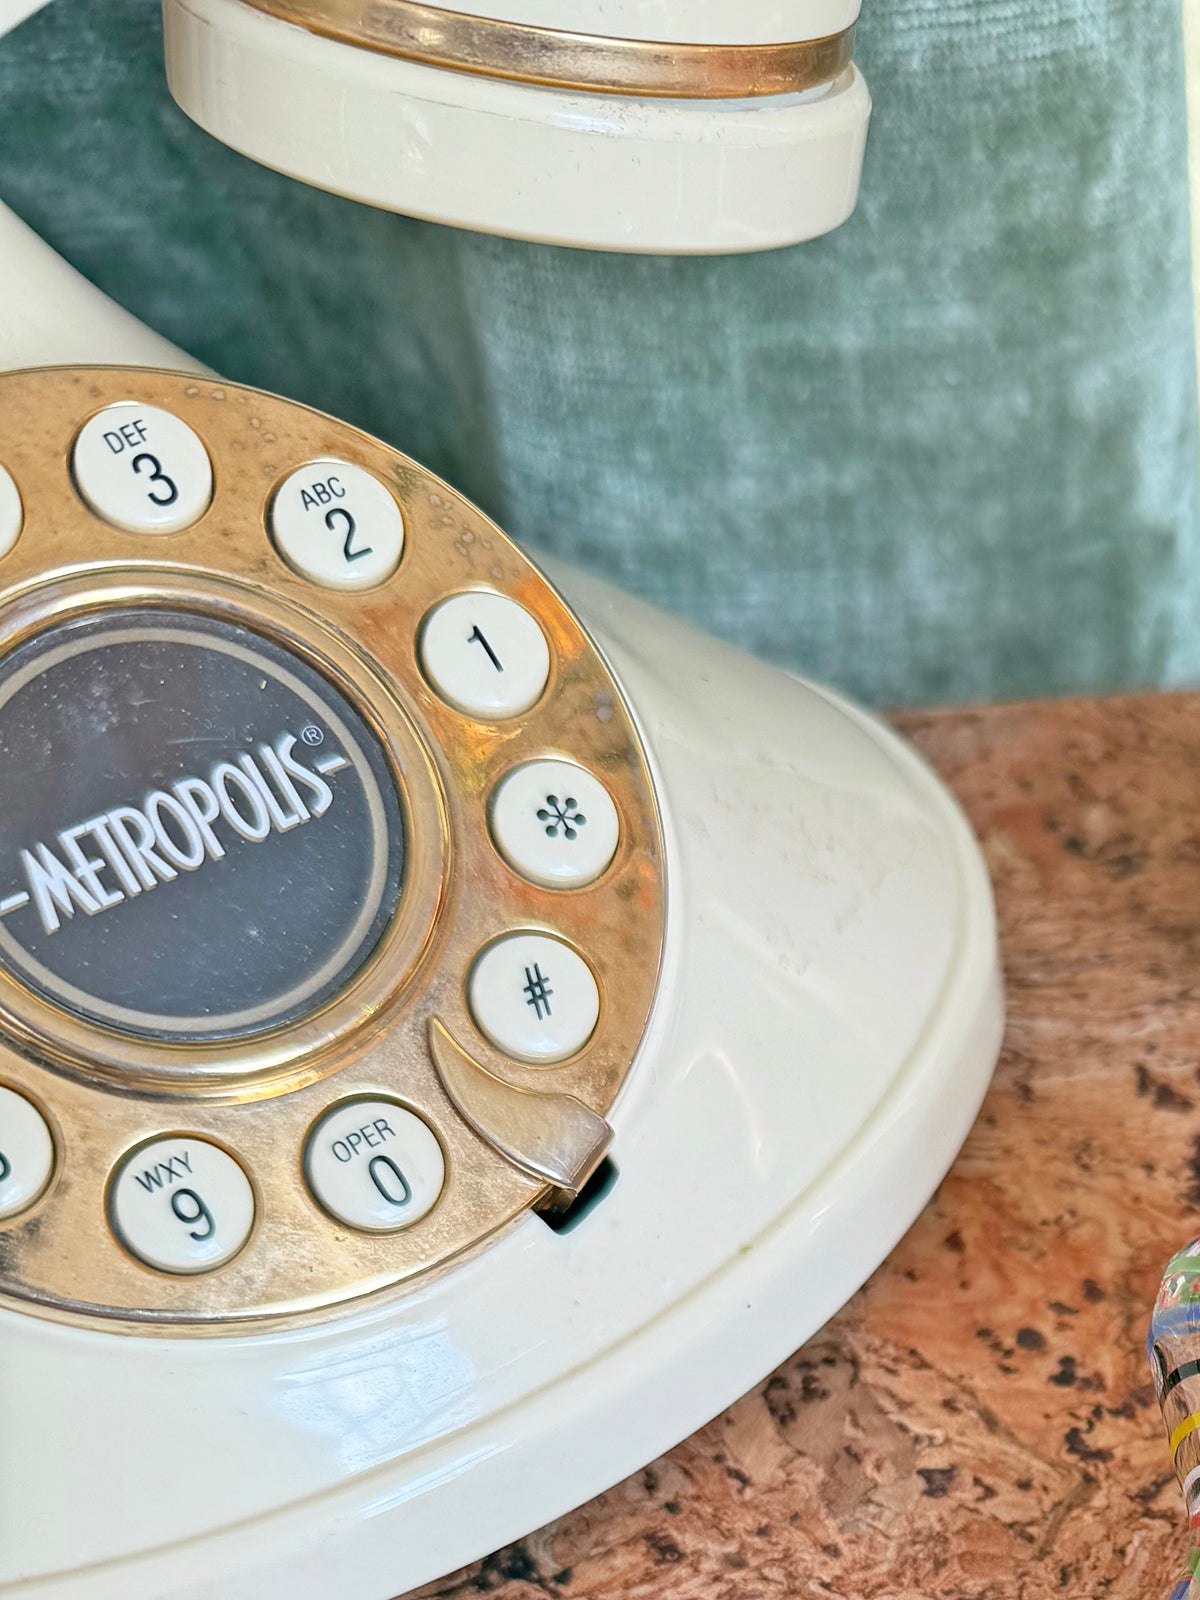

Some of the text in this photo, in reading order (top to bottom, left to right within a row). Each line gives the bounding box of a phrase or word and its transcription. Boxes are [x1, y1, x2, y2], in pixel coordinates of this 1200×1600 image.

[103, 418, 150, 455] DEF
[131, 452, 179, 508] 3
[300, 476, 348, 512] ABC
[324, 507, 373, 564] 2
[466, 624, 504, 673] 1
[522, 962, 554, 1021] #
[331, 1118, 396, 1164] OPER
[135, 1152, 195, 1194] WXY
[368, 1154, 411, 1207] 0
[170, 1188, 216, 1242] 9
